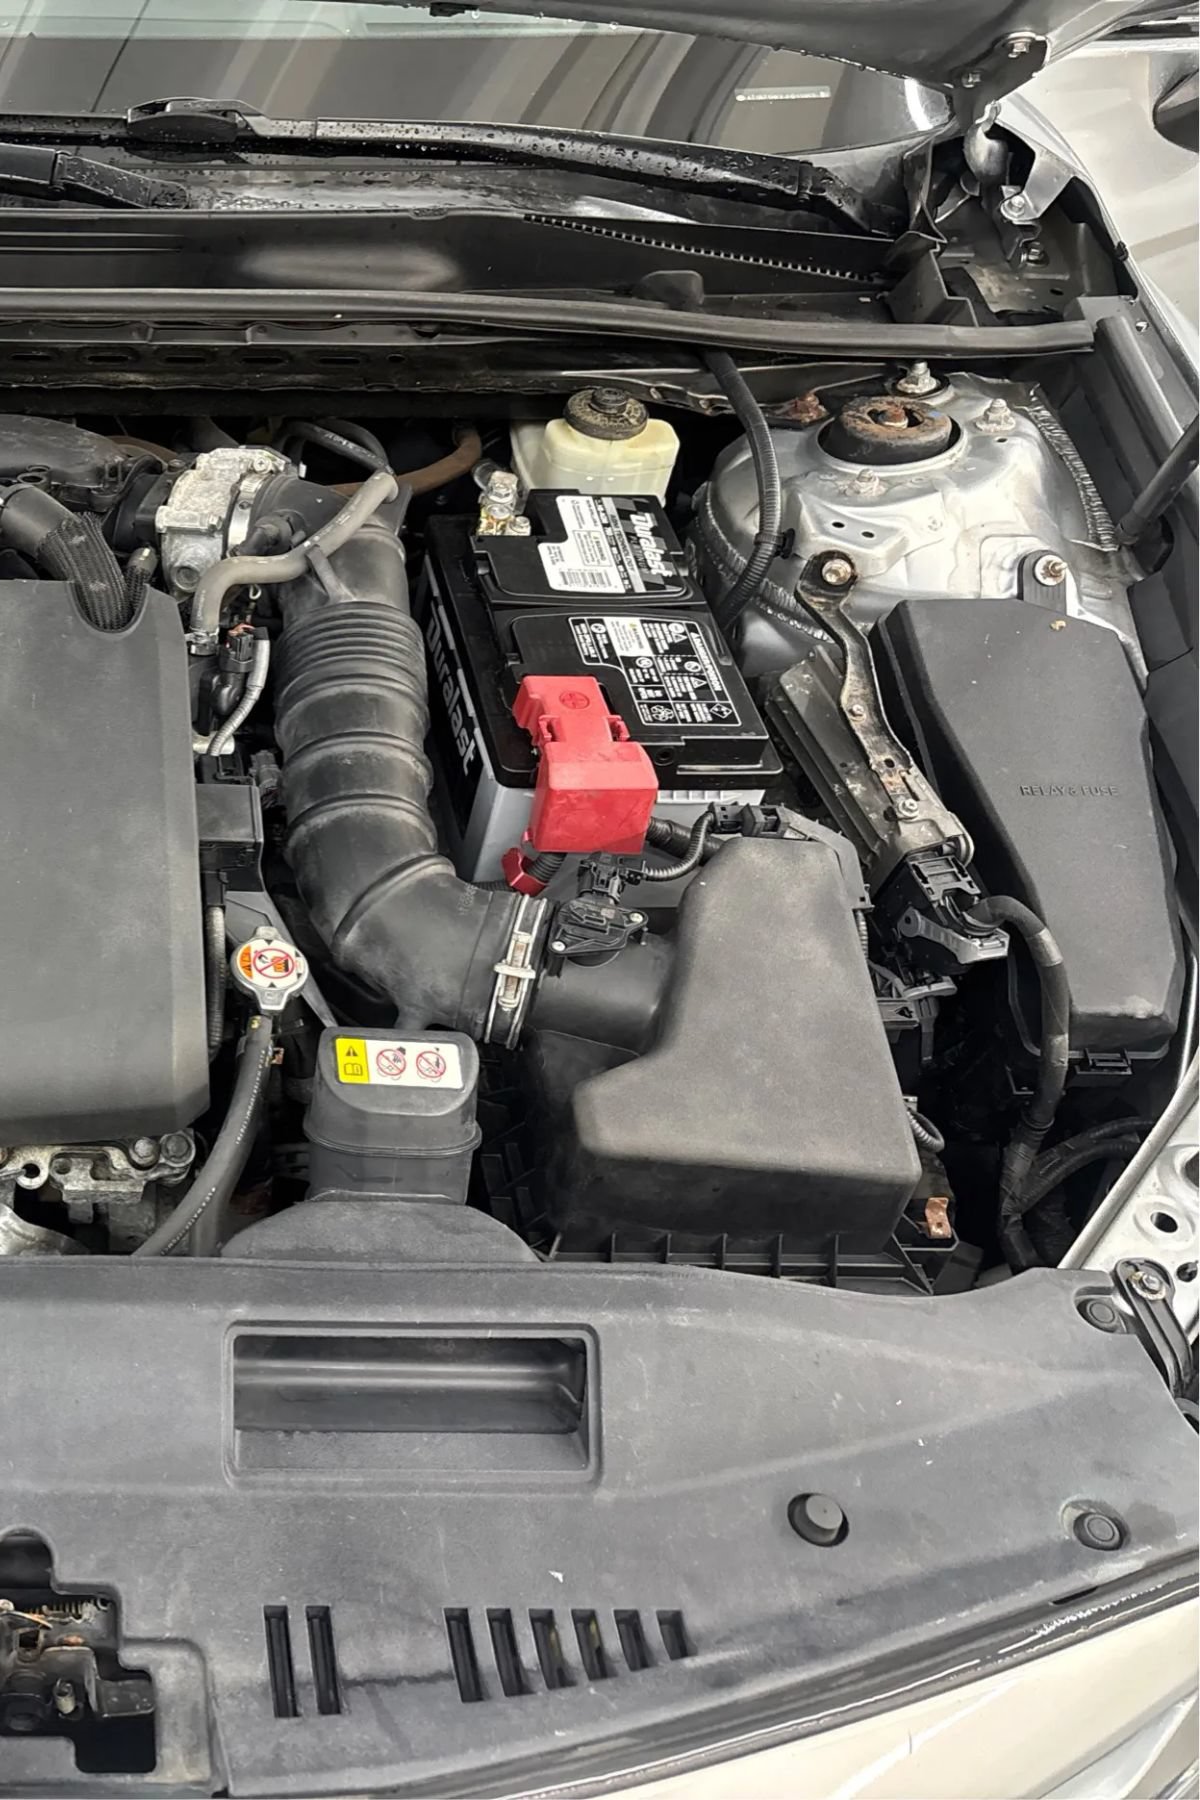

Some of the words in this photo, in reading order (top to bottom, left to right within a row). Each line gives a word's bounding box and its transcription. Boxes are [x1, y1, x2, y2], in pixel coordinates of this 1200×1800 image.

[630, 512, 673, 577] Duralast
[426, 600, 476, 776] Duralast
[1019, 785, 1065, 796] RELAY
[1081, 785, 1119, 796] FUSE
